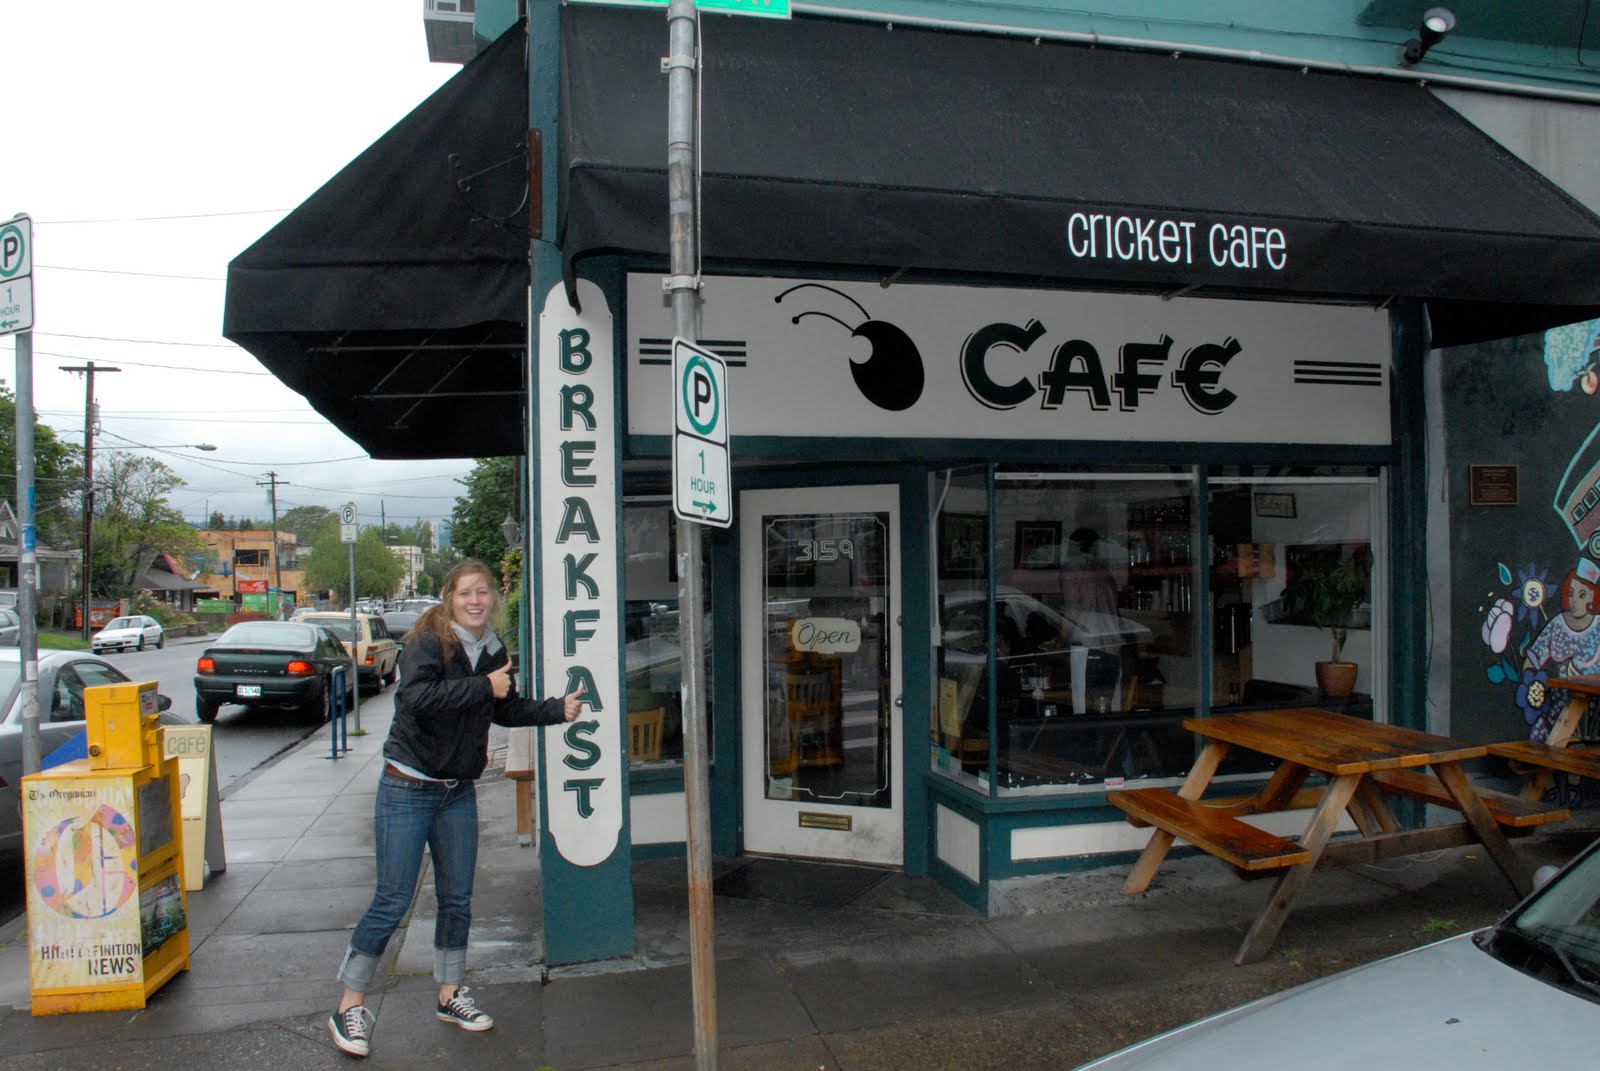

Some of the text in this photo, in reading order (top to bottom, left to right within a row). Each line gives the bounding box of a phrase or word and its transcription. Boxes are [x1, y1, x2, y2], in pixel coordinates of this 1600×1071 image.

[4, 236, 18, 269] P
[0, 304, 20, 317] HOUR
[693, 371, 711, 418] P
[698, 449, 705, 475] 1
[690, 476, 715, 495] HOUR
[796, 539, 854, 561] 3159
[555, 327, 606, 819] BREAKFAST
[798, 622, 856, 651] Open
[49, 788, 96, 801] Oregonian
[88, 956, 135, 976] NEWS
